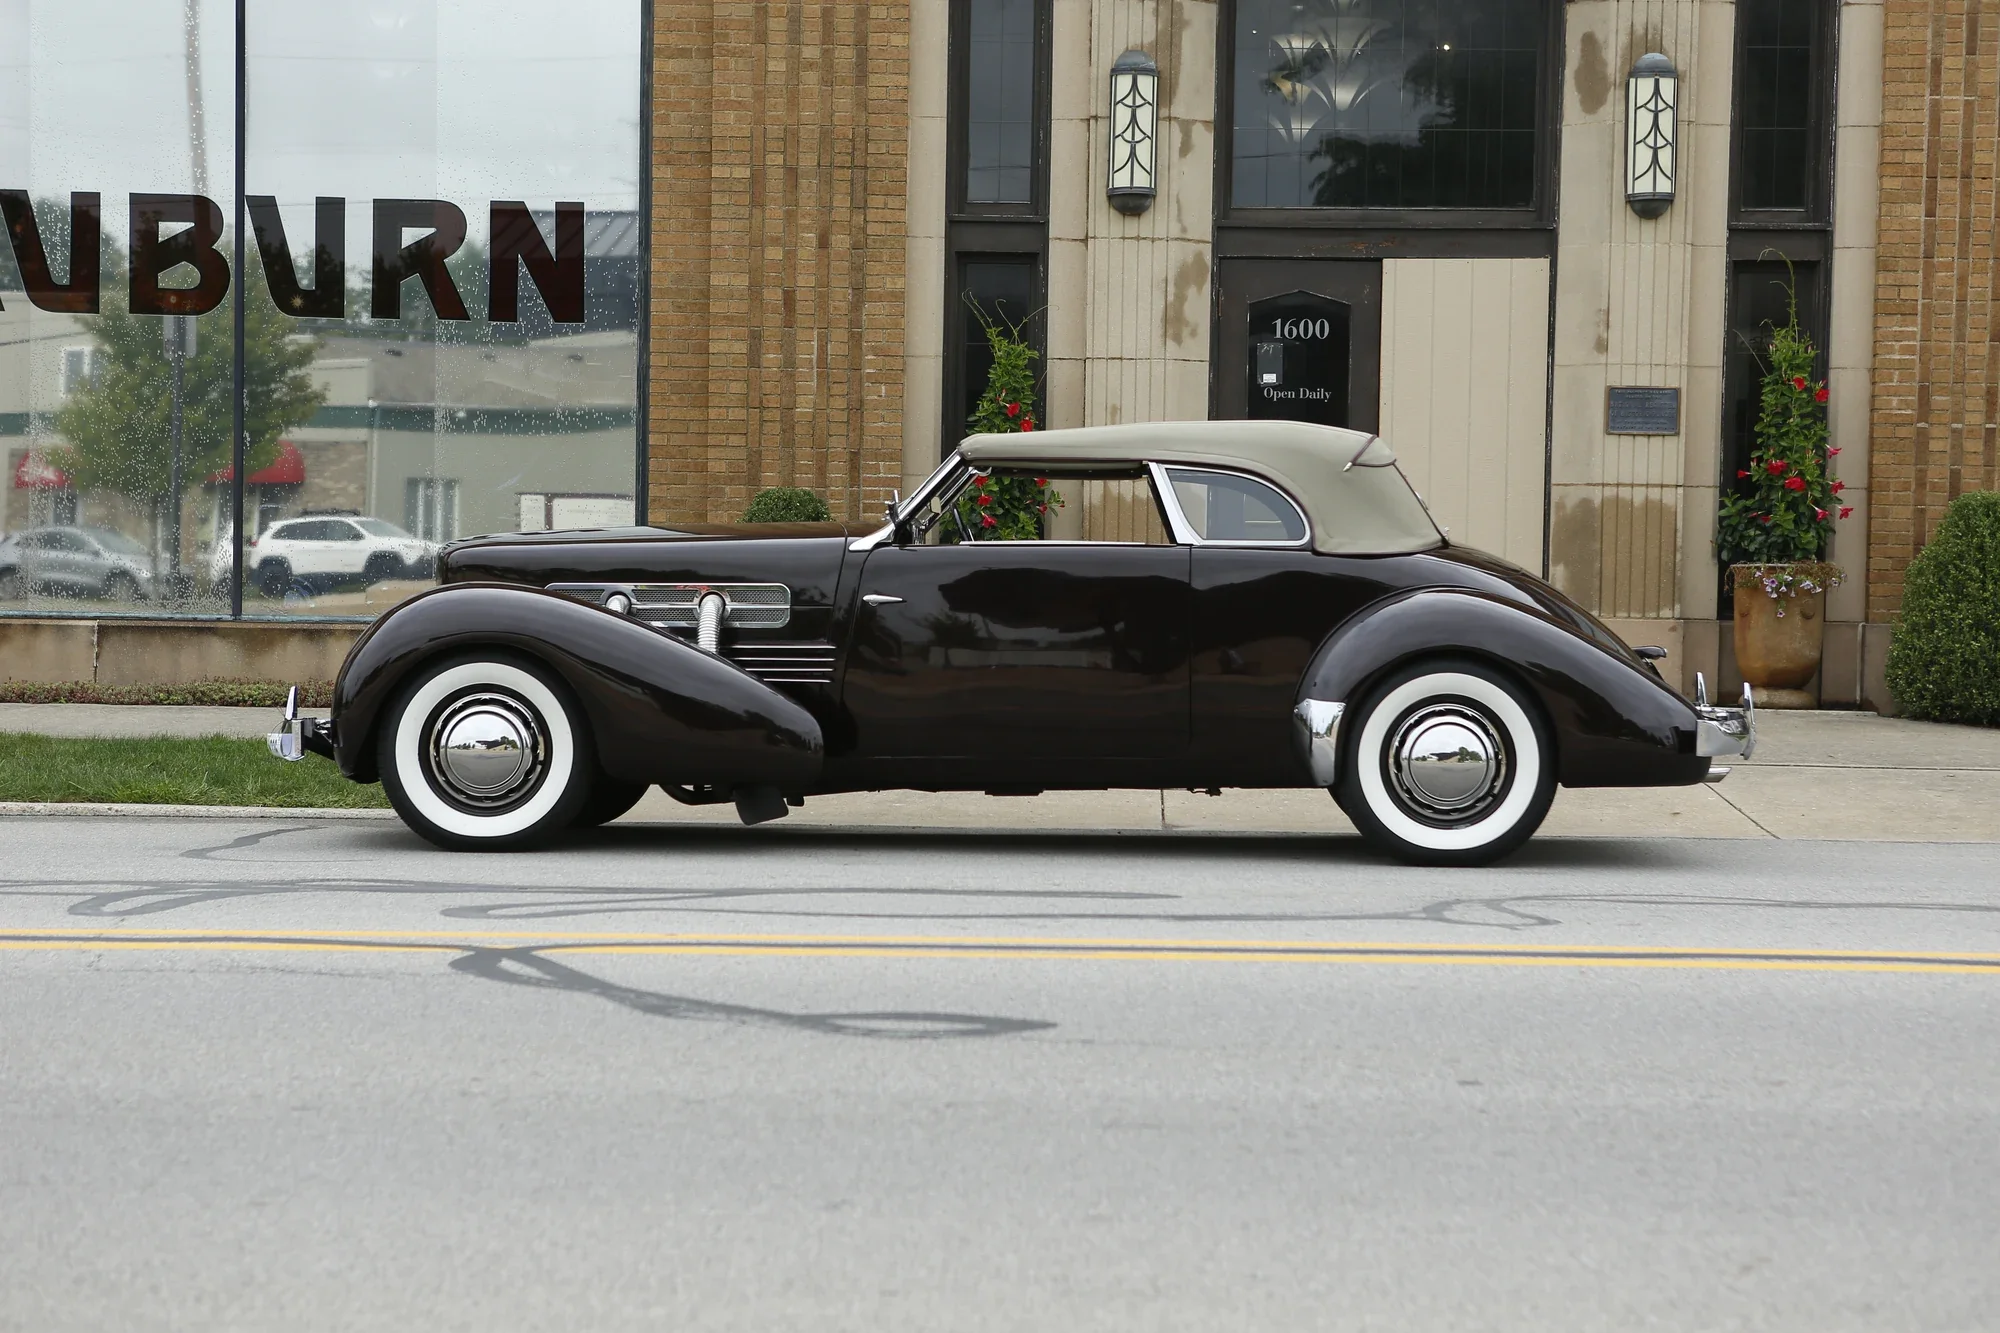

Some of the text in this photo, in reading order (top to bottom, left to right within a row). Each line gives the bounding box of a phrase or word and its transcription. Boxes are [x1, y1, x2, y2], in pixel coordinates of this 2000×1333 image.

[0, 189, 586, 323] UBURN
[1272, 318, 1330, 339] 1600
[1263, 387, 1332, 402] Open Daily
